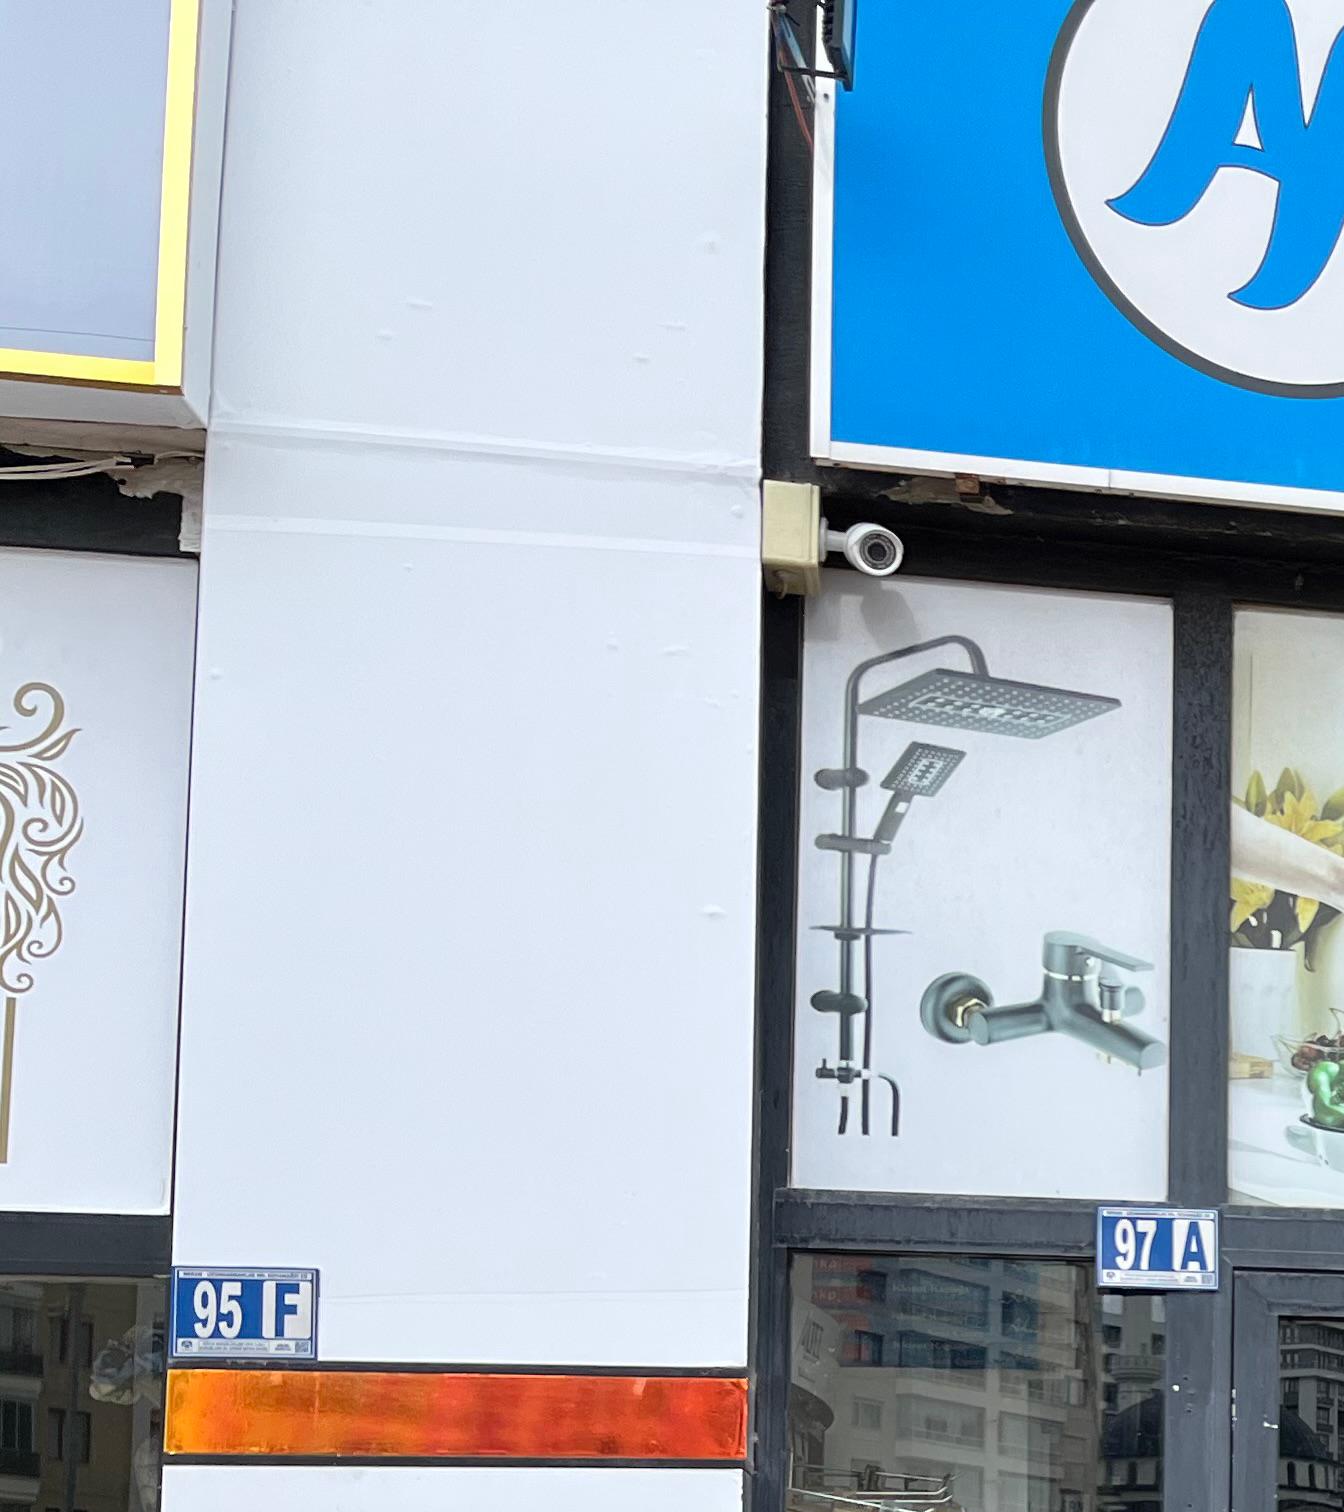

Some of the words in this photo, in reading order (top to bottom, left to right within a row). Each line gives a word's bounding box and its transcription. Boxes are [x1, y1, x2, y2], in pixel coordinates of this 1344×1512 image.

[1114, 1218, 1157, 1271] 97
[1179, 1220, 1209, 1271] A
[193, 1280, 242, 1339] 95
